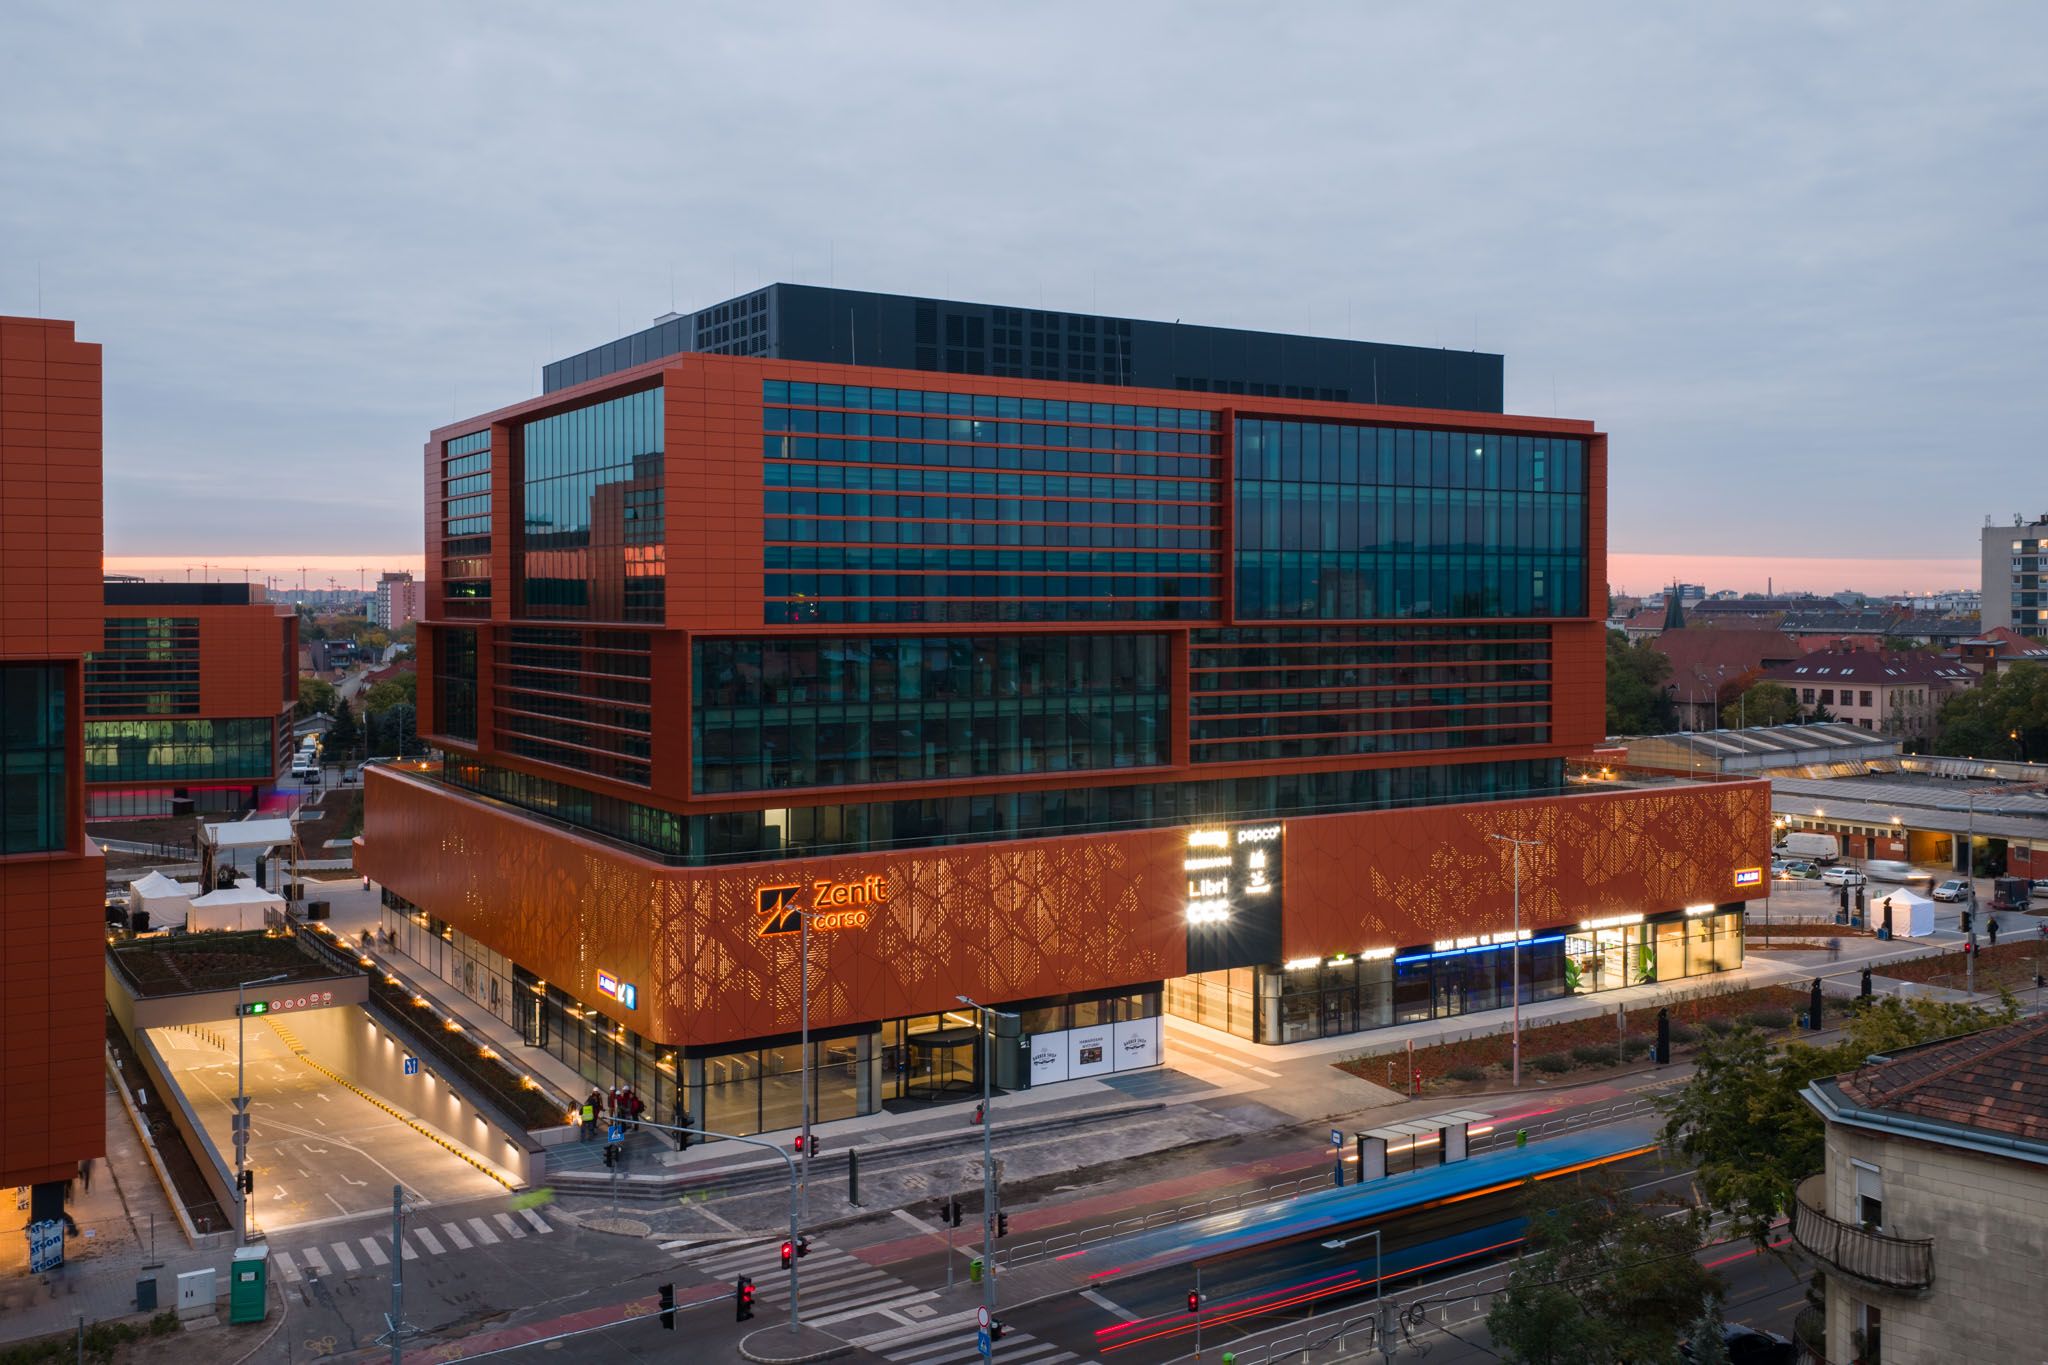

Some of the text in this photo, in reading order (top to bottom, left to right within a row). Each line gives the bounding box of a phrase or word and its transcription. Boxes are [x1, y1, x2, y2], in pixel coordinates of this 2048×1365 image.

[814, 877, 886, 907] Zenit
[1189, 877, 1228, 897] Libri
[815, 911, 866, 929] corso
